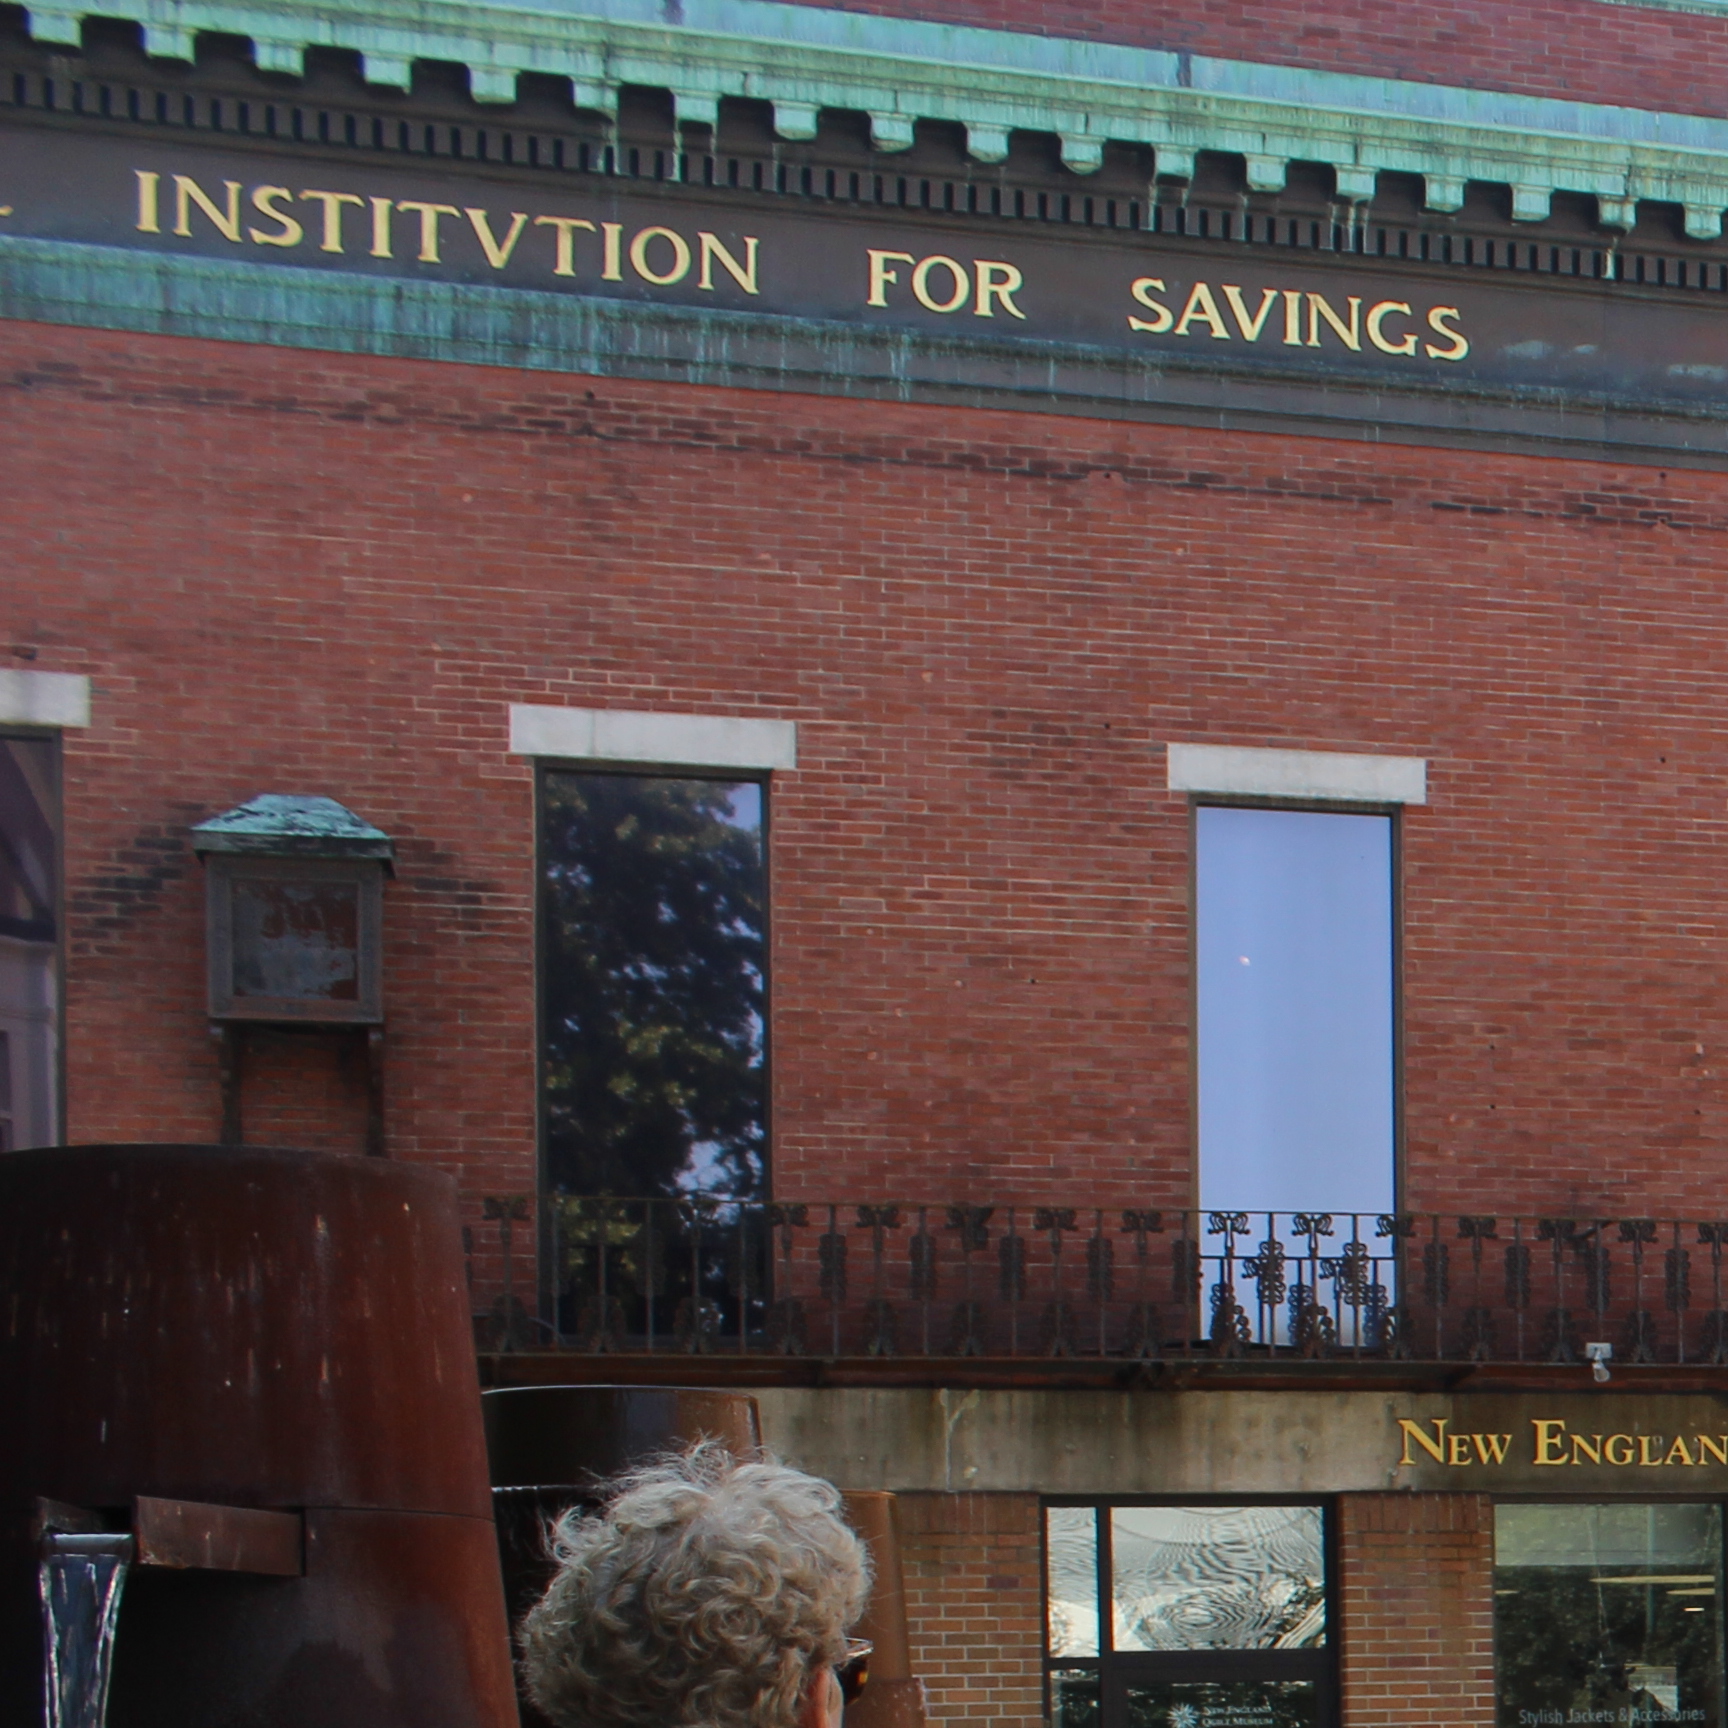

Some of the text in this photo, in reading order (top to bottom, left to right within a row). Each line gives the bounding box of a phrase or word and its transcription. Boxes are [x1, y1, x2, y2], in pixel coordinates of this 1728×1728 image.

[133, 169, 1470, 361] INSTITVTION FOR SAVINGS
[1519, 1707, 1706, 1728] Stylish Jackets & Accessories
